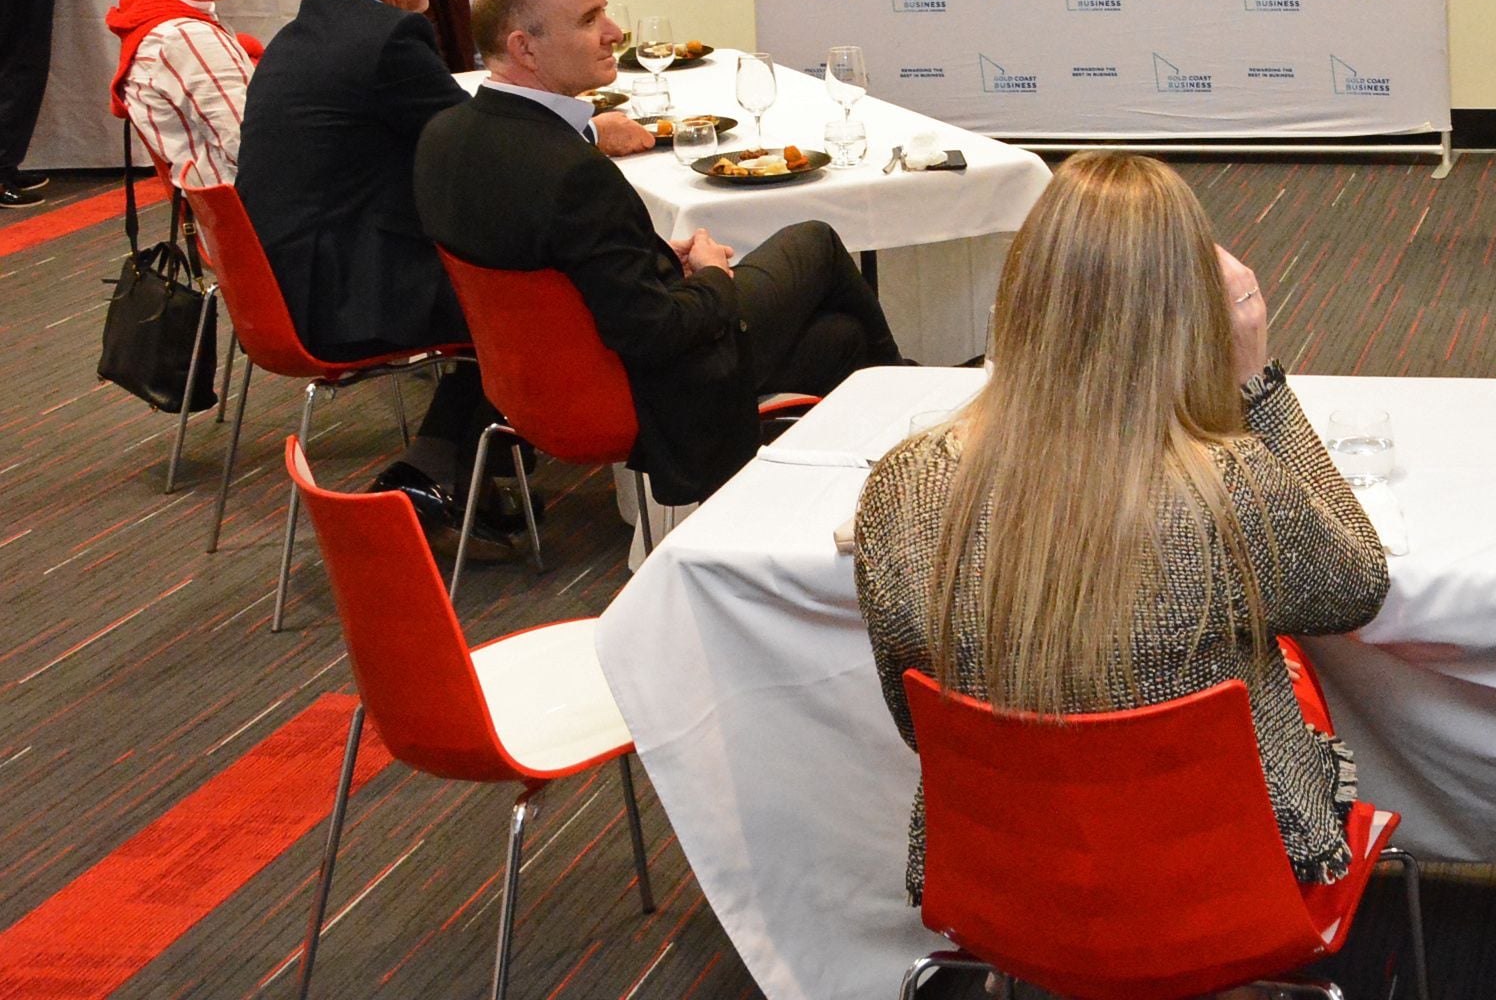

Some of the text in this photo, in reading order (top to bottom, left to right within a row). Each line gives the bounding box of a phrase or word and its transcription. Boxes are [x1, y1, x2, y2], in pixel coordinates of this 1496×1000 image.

[904, 1, 947, 9] BUSINESS
[1078, 0, 1122, 8] BUSINESS
[1256, 0, 1300, 8] BUSINESS
[1168, 81, 1212, 89] BUSINESS
[1346, 84, 1391, 92] BUSINESS
